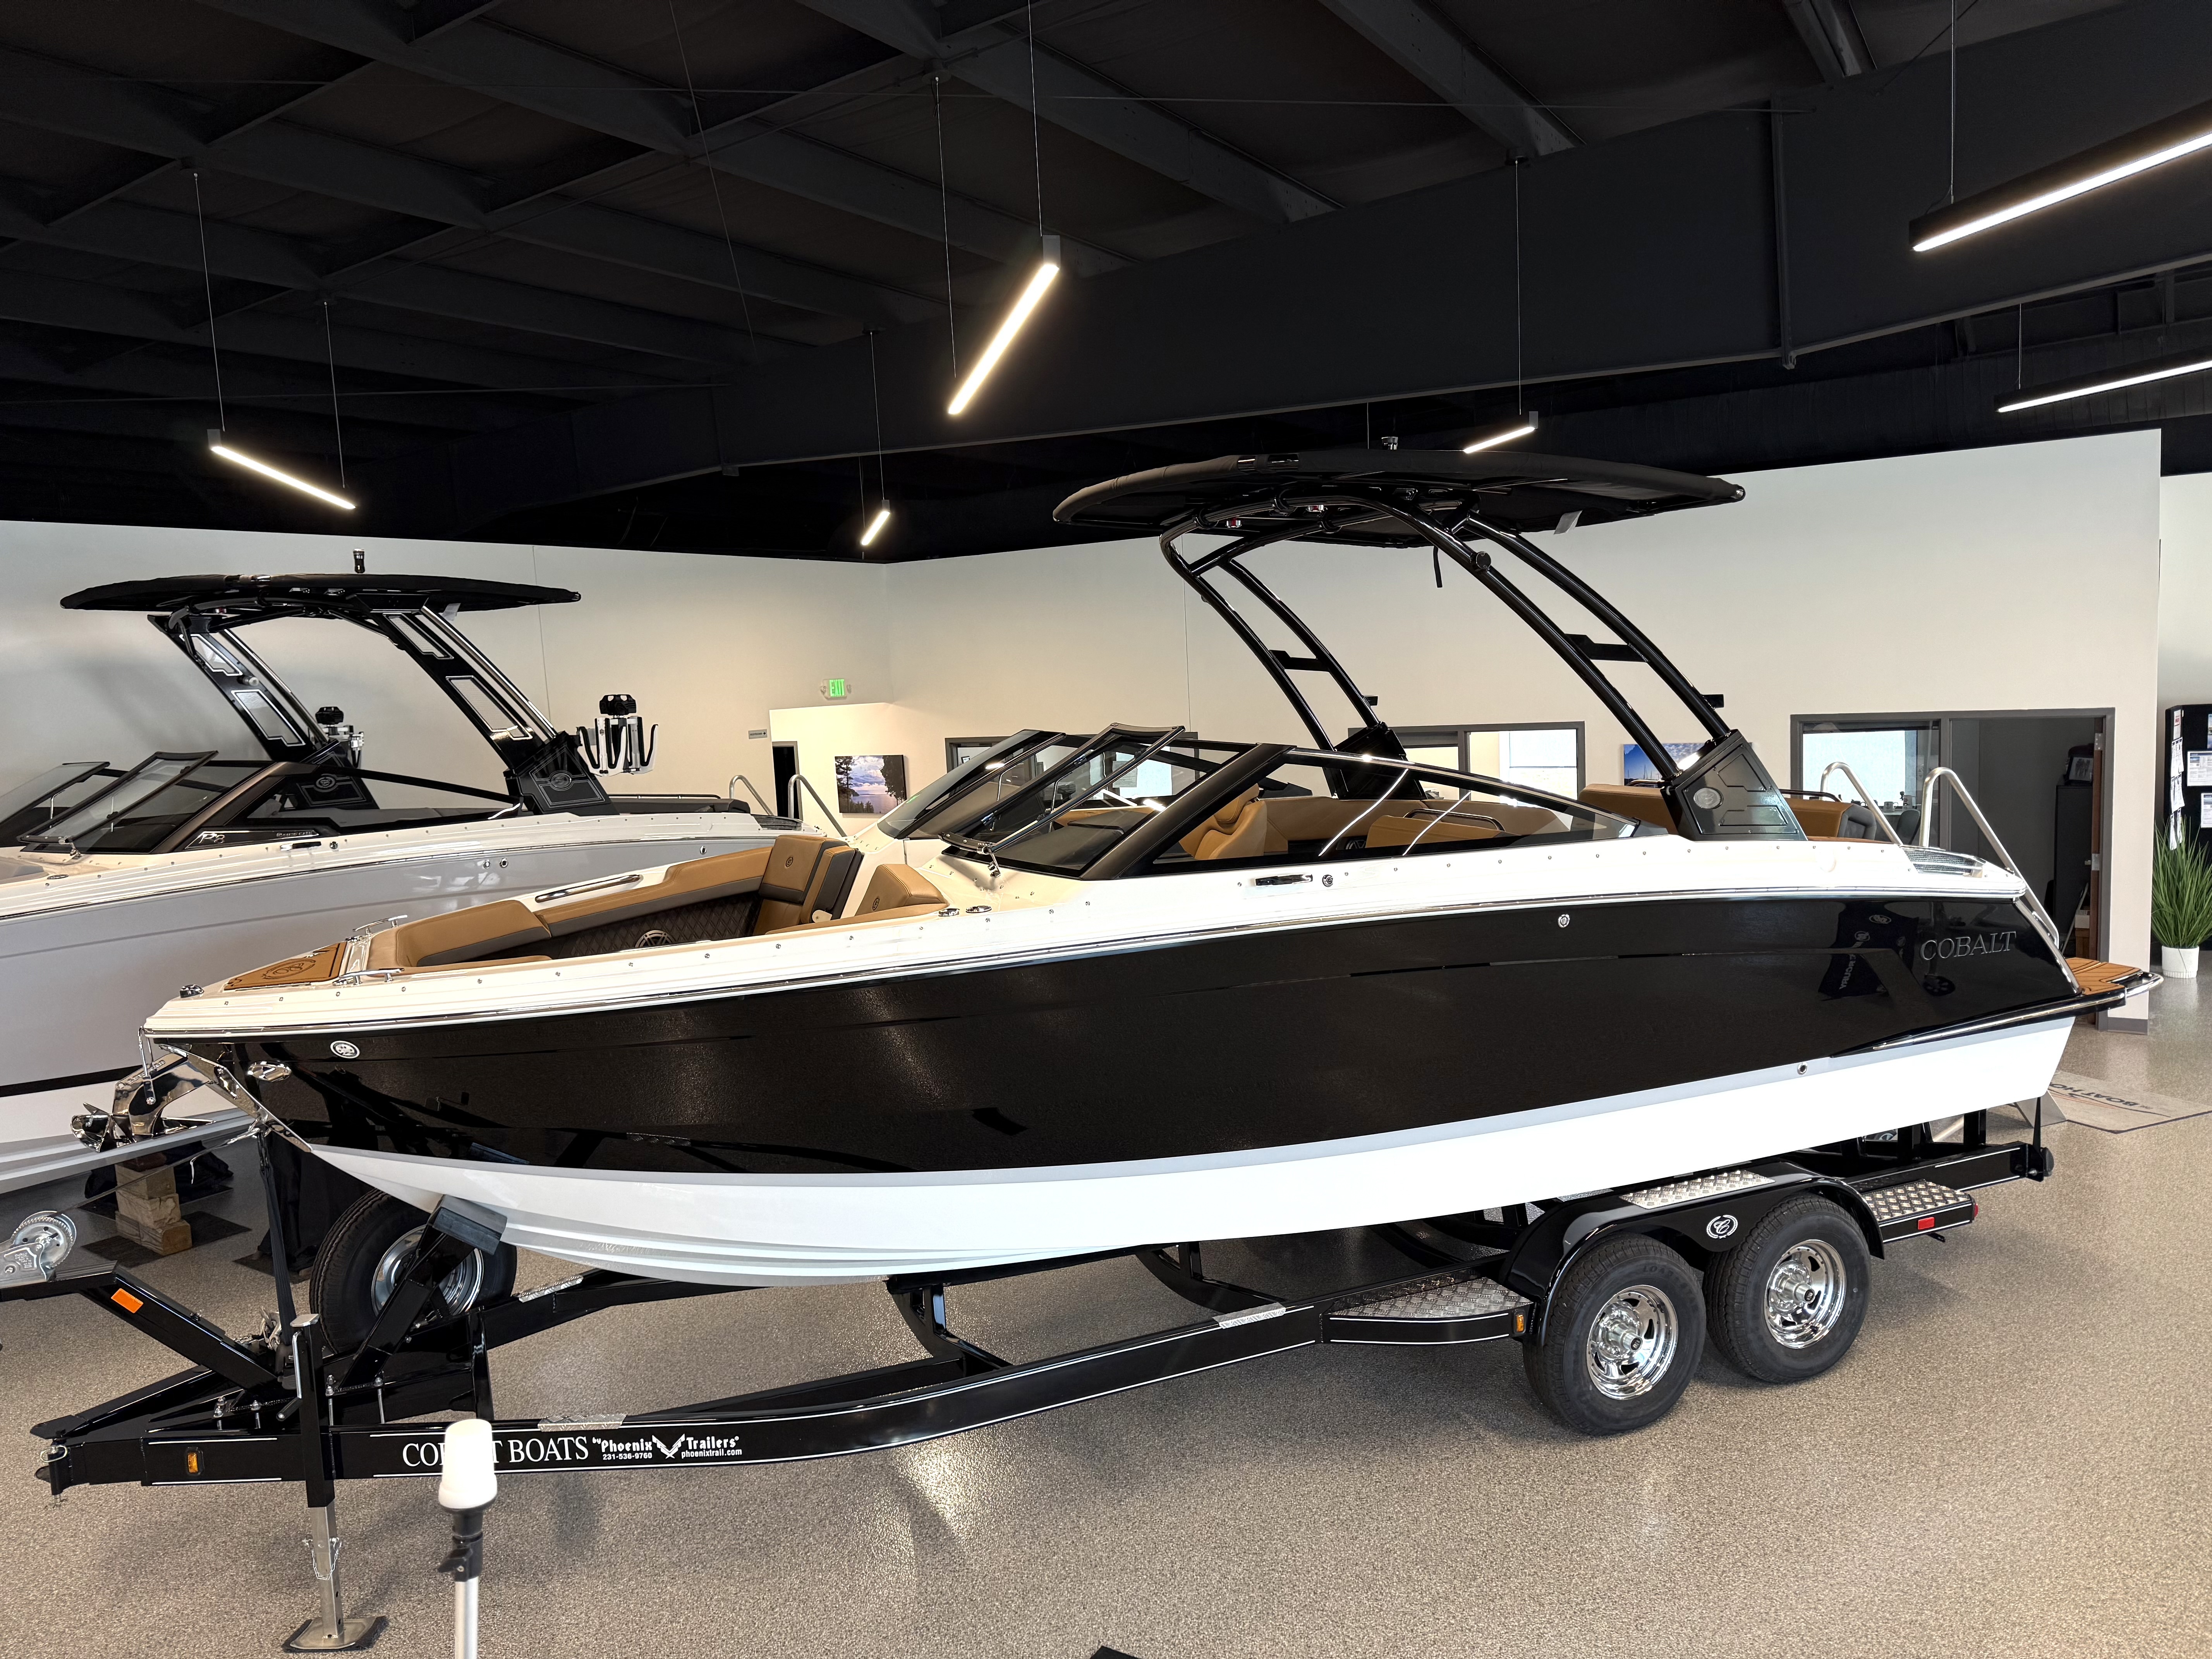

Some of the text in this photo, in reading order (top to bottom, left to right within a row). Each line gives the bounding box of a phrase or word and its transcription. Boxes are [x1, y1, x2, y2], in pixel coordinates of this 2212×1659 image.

[830, 679, 845, 697] EXIT
[1920, 931, 2016, 960] COBALT
[2049, 1082, 2085, 1092] HO
[2081, 1092, 2140, 1106] BOAT
[403, 1436, 589, 1467] COT BOATS
[601, 1438, 653, 1453] Phoenix
[681, 1449, 742, 1459] phoenixtrail.com
